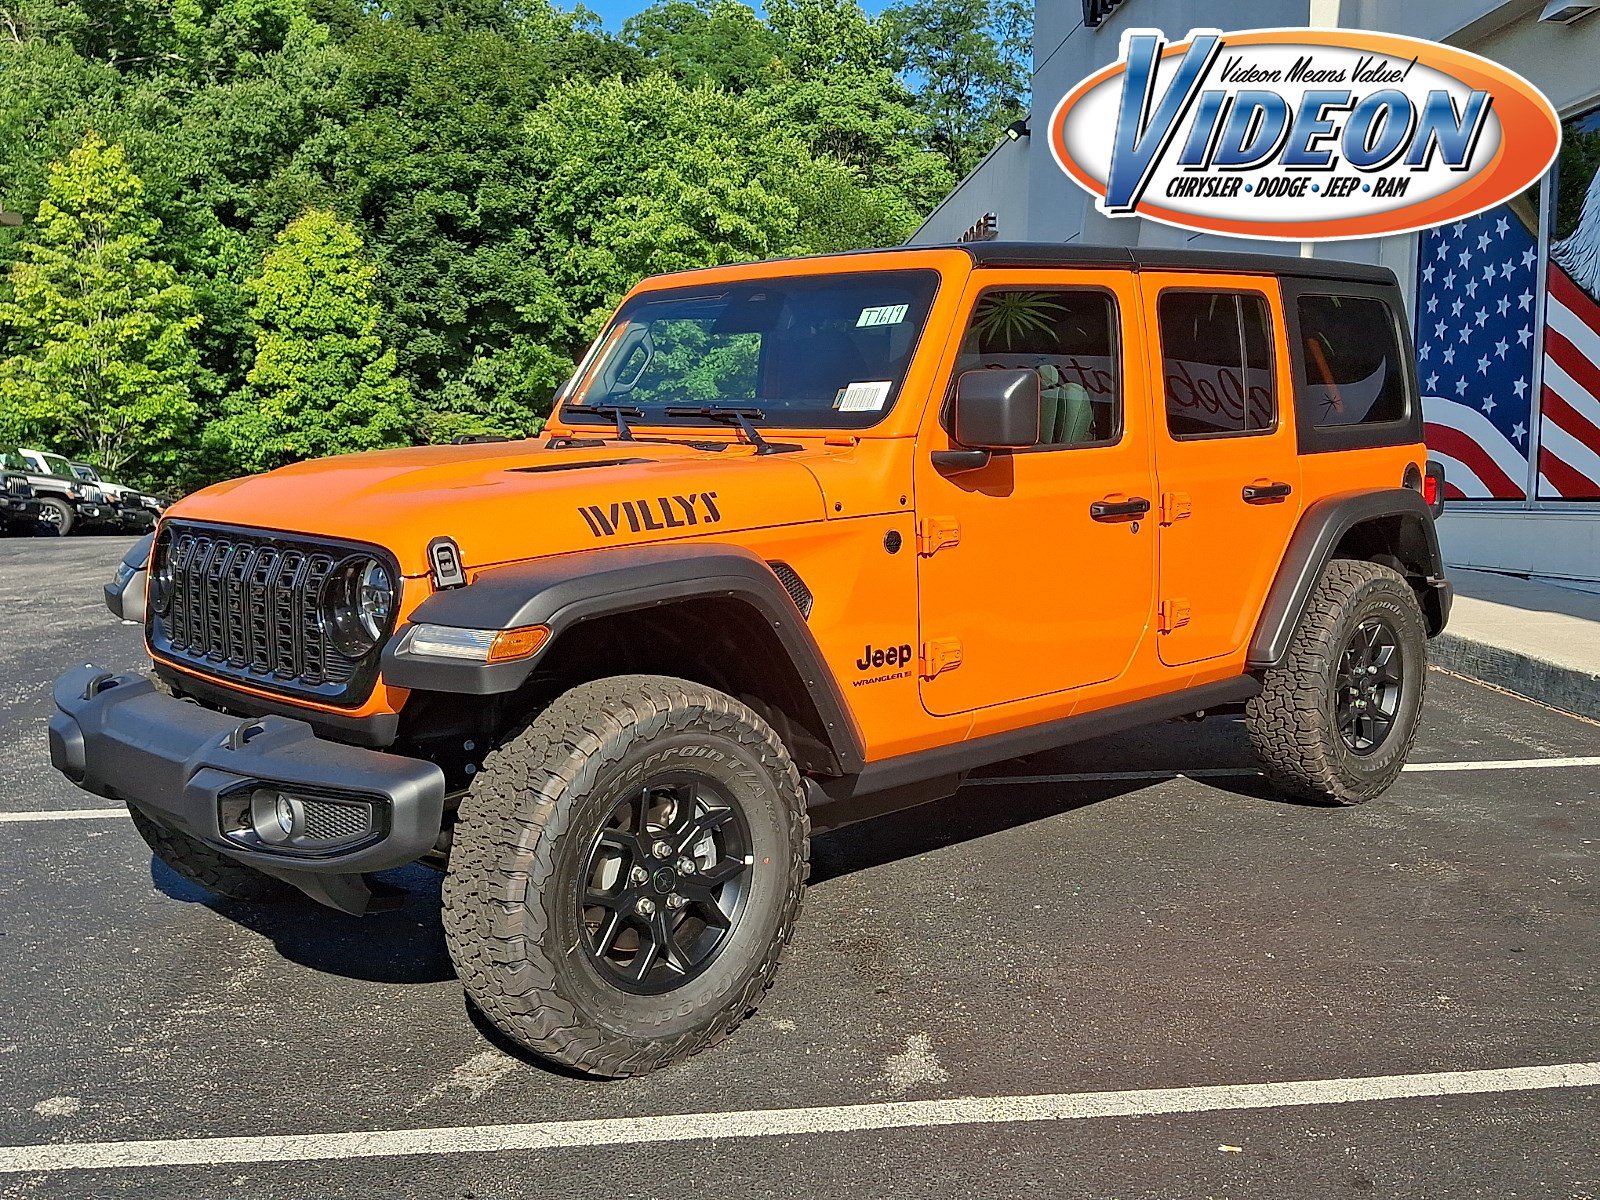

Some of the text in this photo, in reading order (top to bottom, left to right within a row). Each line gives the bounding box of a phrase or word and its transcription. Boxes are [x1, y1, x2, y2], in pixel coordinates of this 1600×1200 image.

[577, 491, 721, 537] WILLYS
[856, 644, 912, 671] Jeep
[852, 672, 903, 687] WRANGLER
